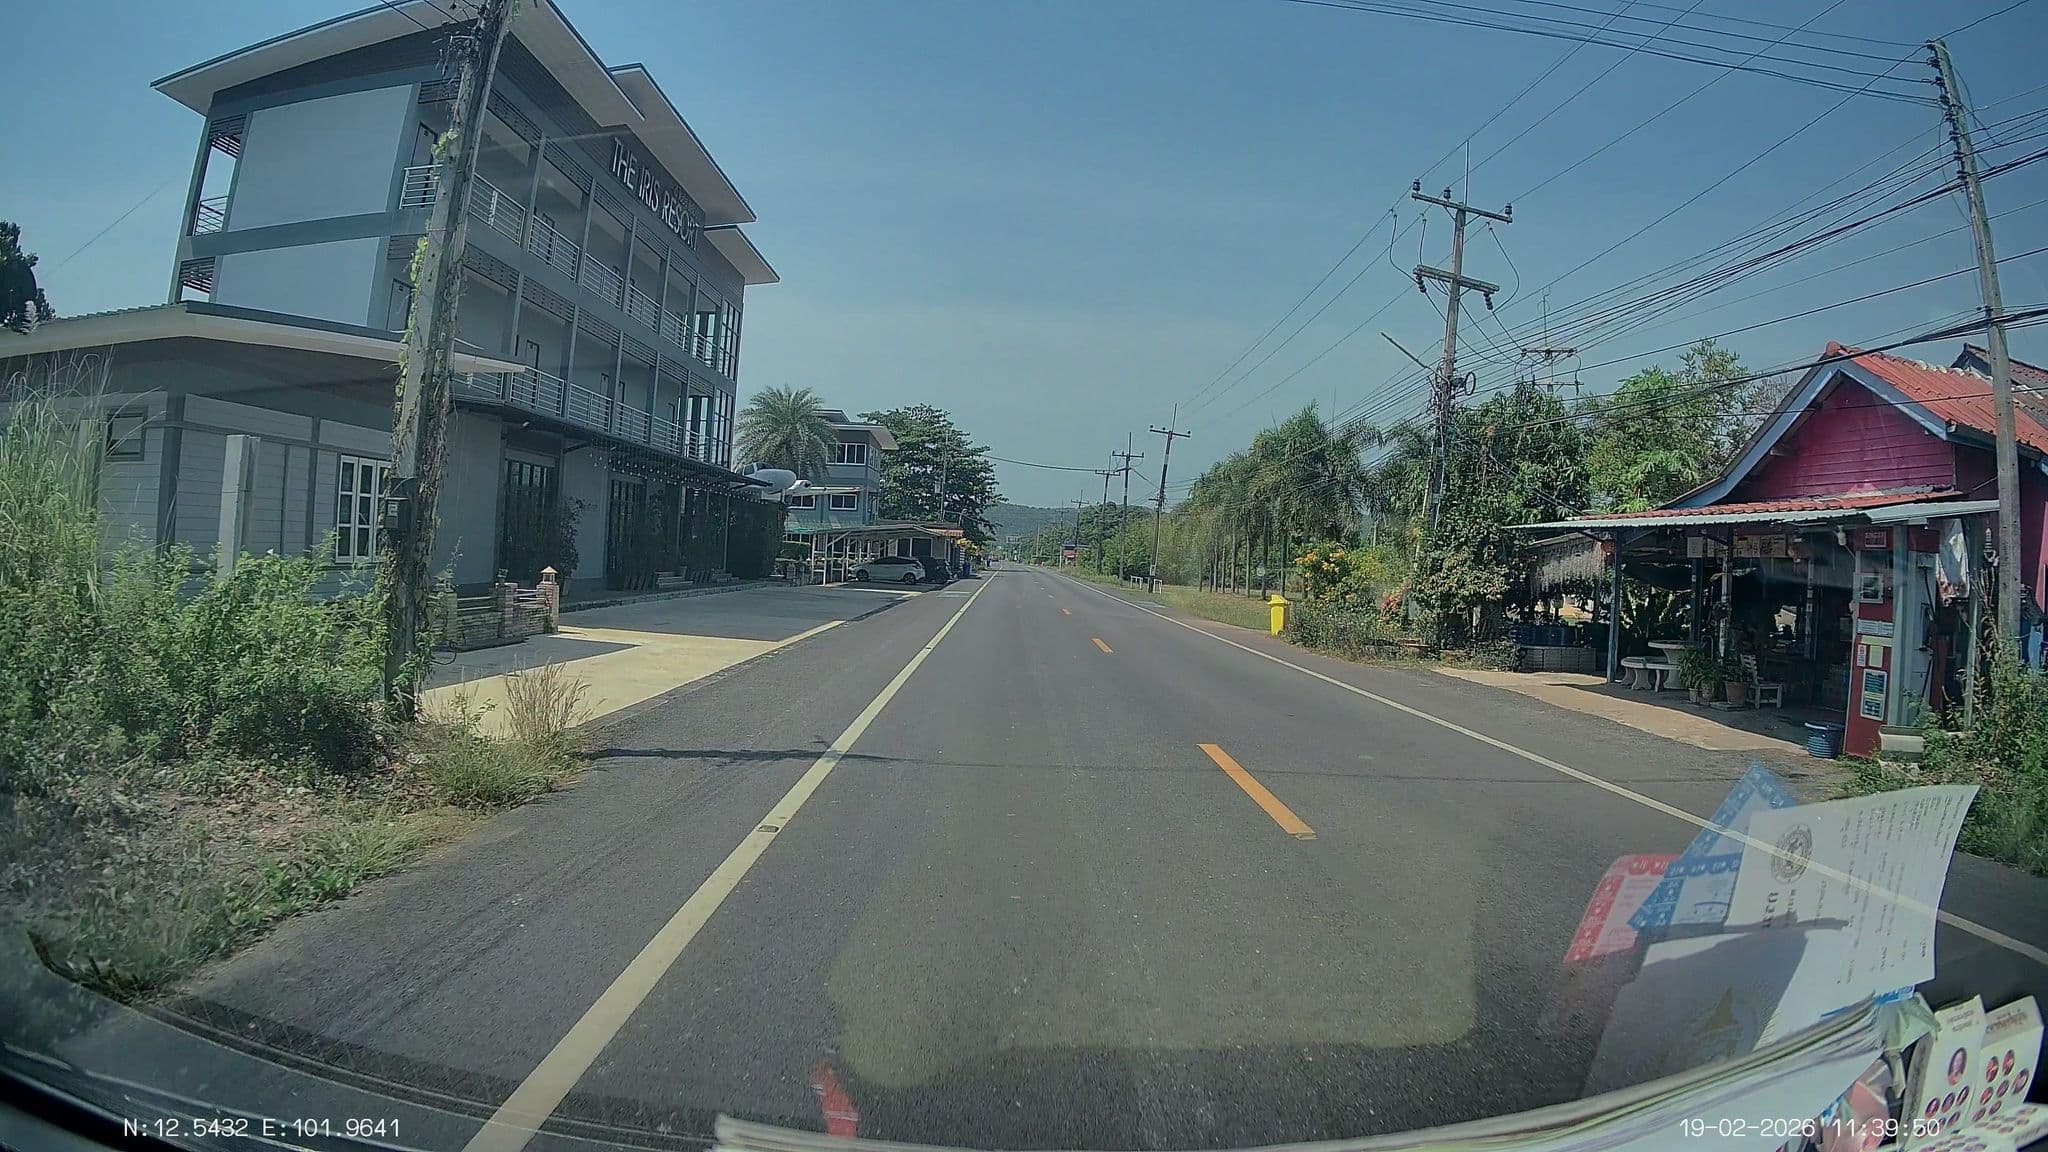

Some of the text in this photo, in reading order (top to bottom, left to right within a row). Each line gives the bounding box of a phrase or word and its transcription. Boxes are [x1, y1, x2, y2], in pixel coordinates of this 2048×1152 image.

[612, 136, 637, 190] THE
[638, 166, 660, 212] IRIS
[661, 190, 700, 251] RESORT
